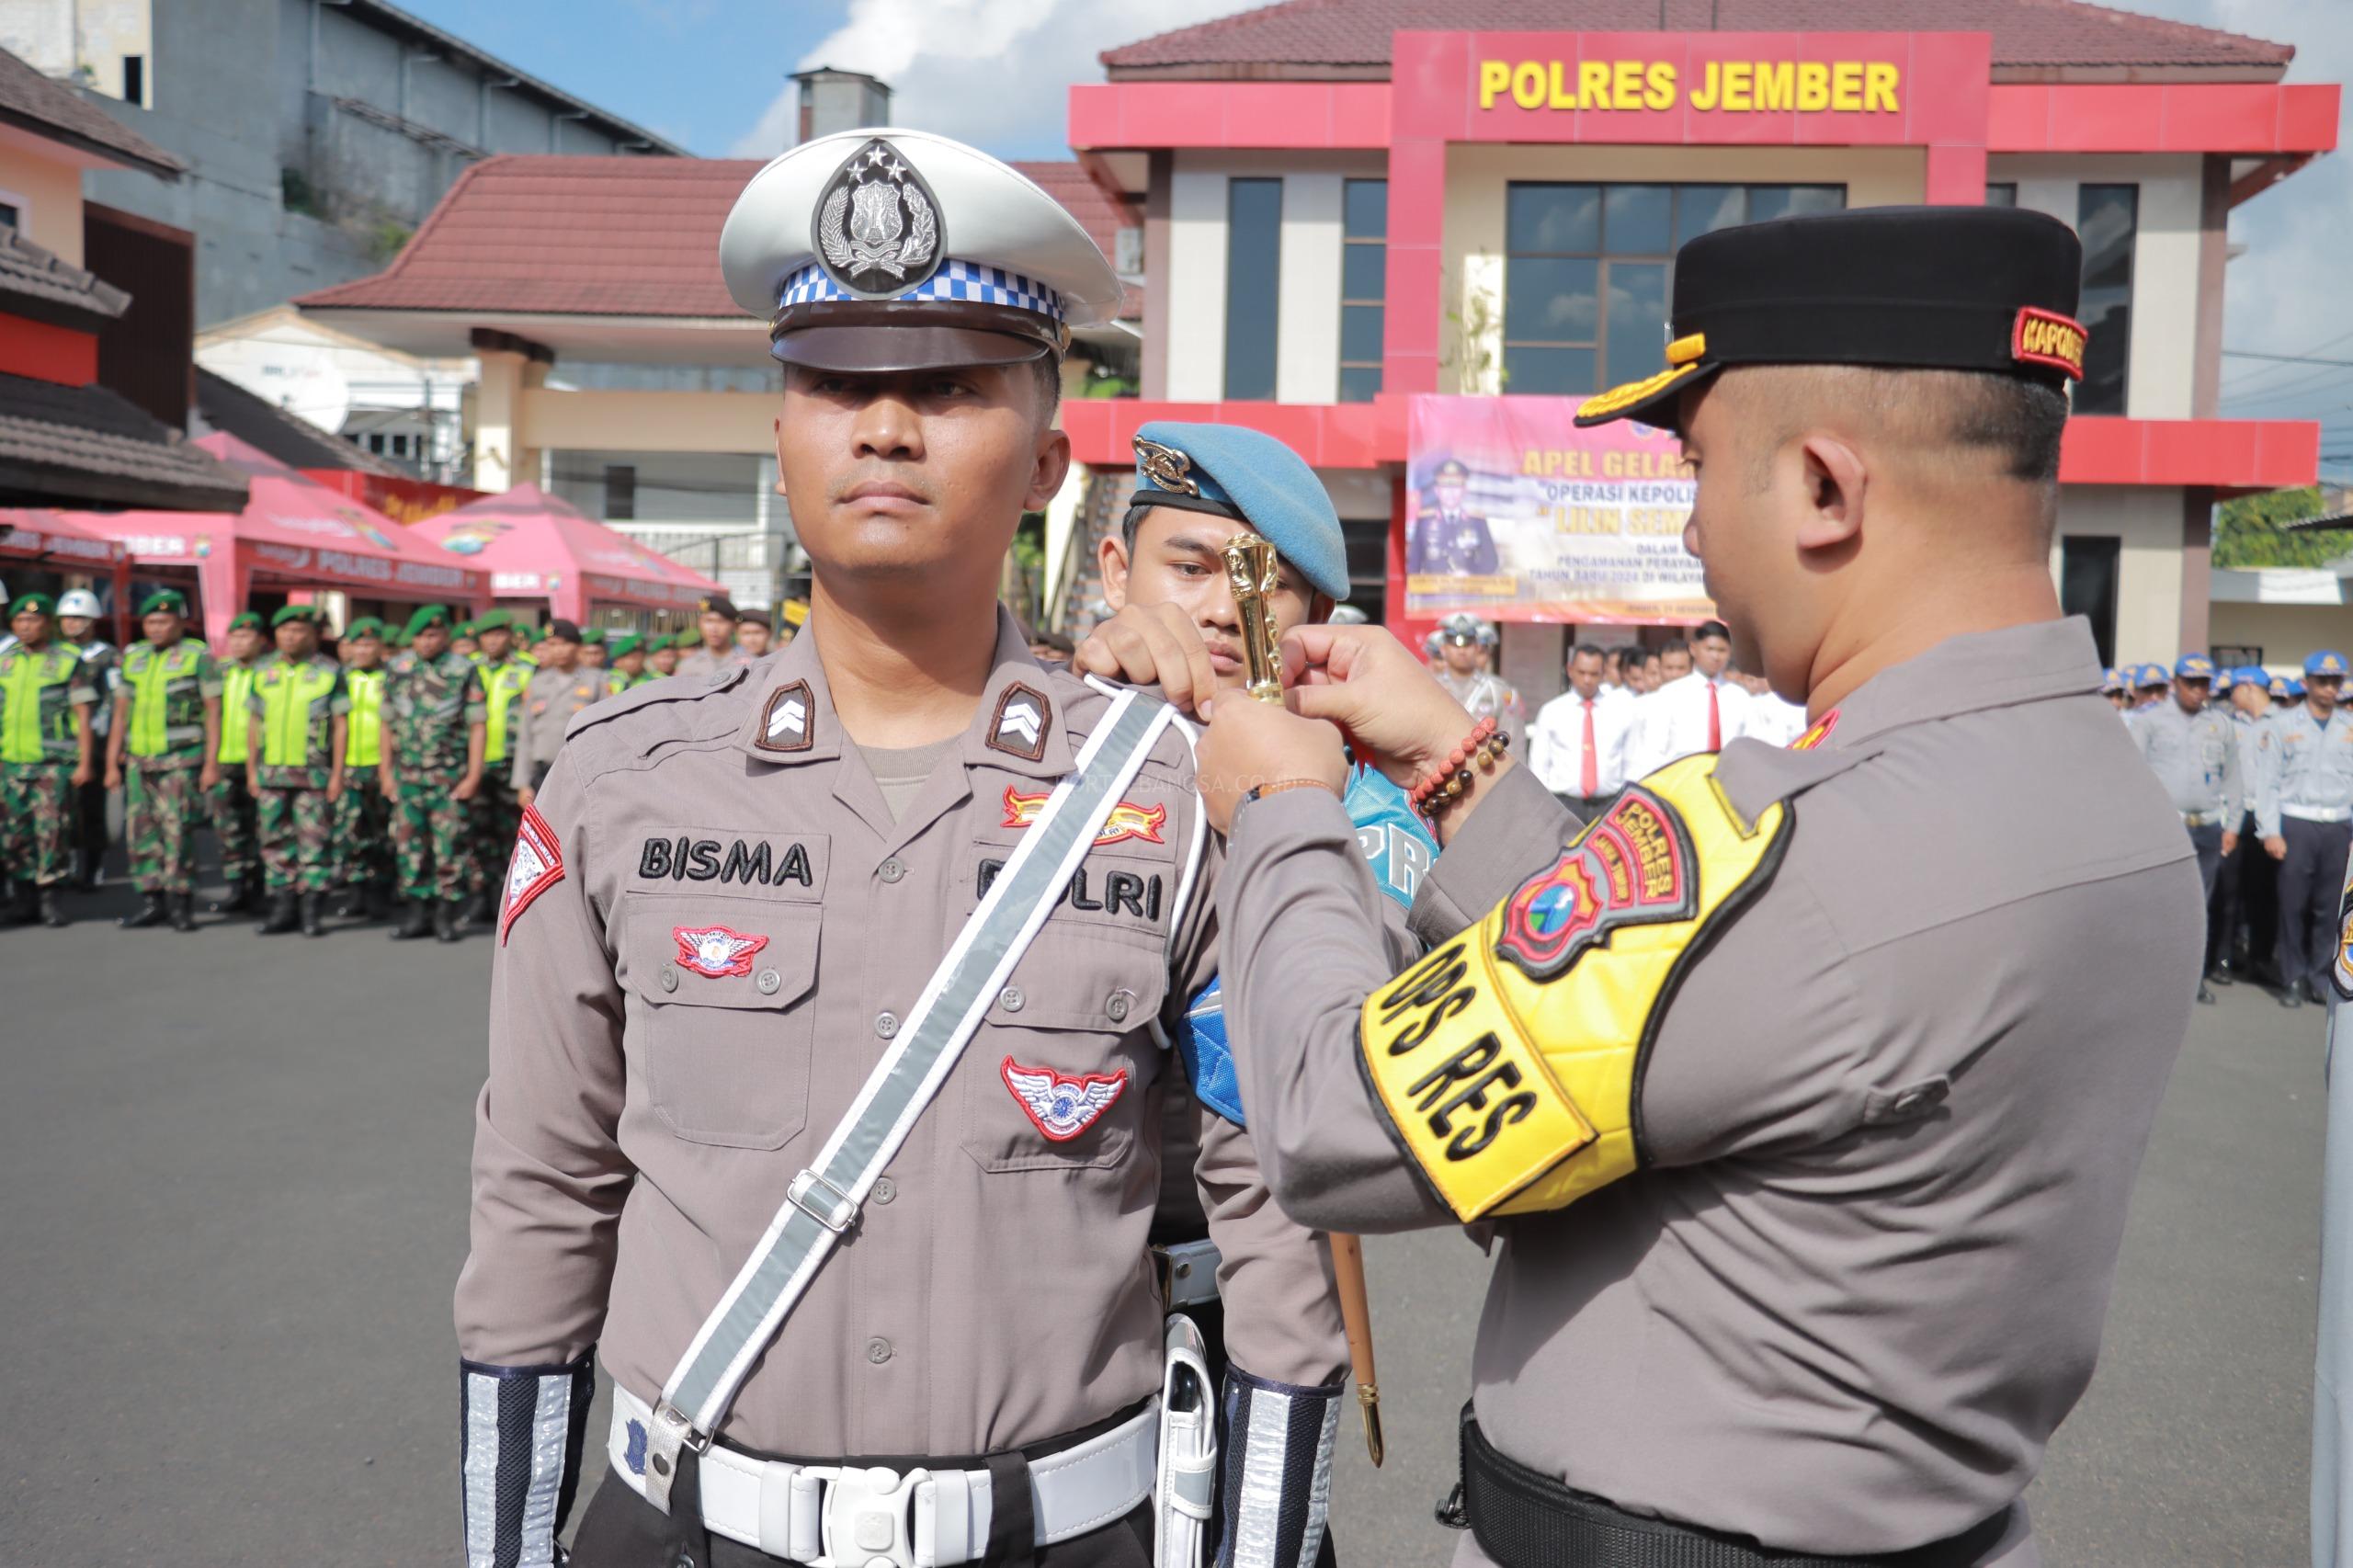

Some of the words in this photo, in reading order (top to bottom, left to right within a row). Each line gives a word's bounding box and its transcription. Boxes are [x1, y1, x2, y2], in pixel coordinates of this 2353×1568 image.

[1479, 61, 1677, 110] POLRES
[1689, 62, 1900, 113] JEMBER
[1522, 449, 1594, 477] APEL
[1547, 483, 1622, 502] OPERASI
[1556, 506, 1620, 535] LILIN
[318, 549, 391, 581] POLRES
[1658, 573, 1703, 584] WILAYA
[639, 835, 813, 887] BISMA
[1356, 823, 1438, 898] PR
[1615, 813, 1661, 900] JEMBER
[1622, 802, 1673, 893] POLRES
[977, 858, 1163, 922] PLRI
[1381, 943, 1476, 1056] OPS
[1407, 1030, 1538, 1163] RES
